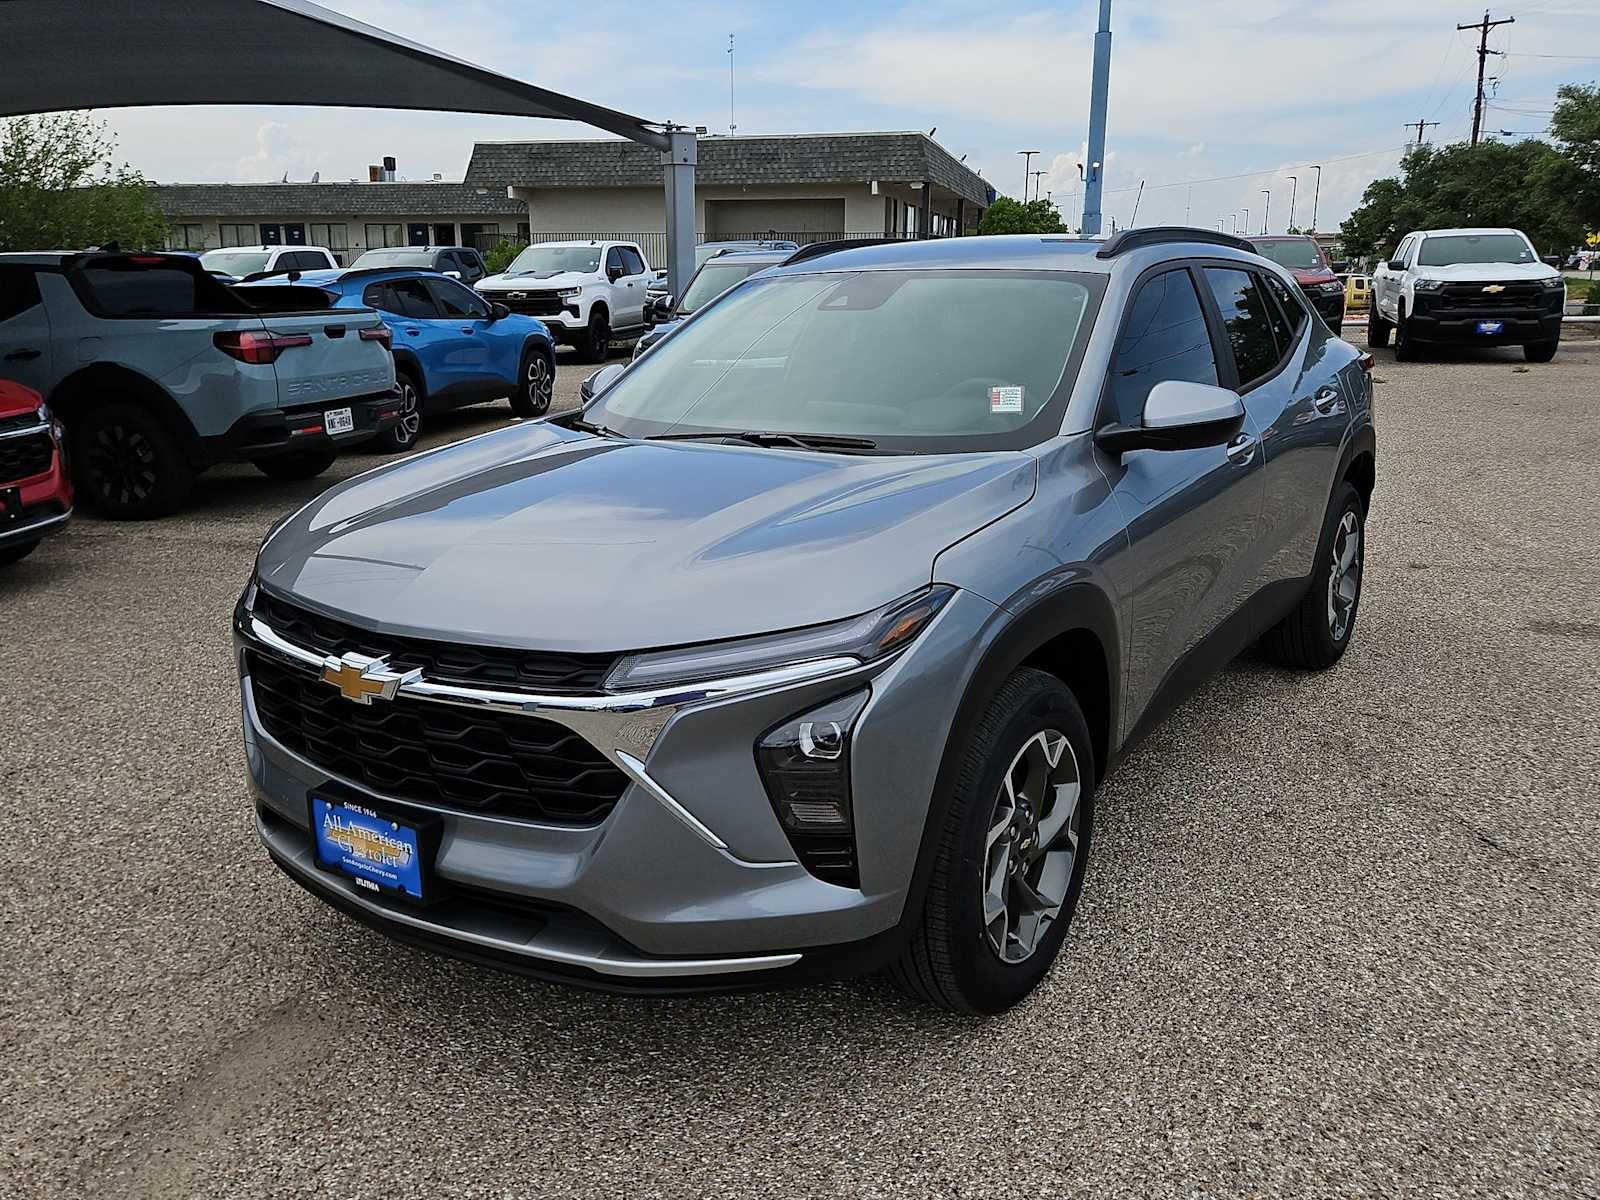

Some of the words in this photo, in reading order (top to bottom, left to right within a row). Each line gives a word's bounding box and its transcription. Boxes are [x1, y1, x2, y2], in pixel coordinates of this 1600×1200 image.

[343, 801, 362, 814] SINCE
[323, 813, 341, 832] All
[346, 820, 413, 854] American
[338, 836, 399, 868] Chevrolet
